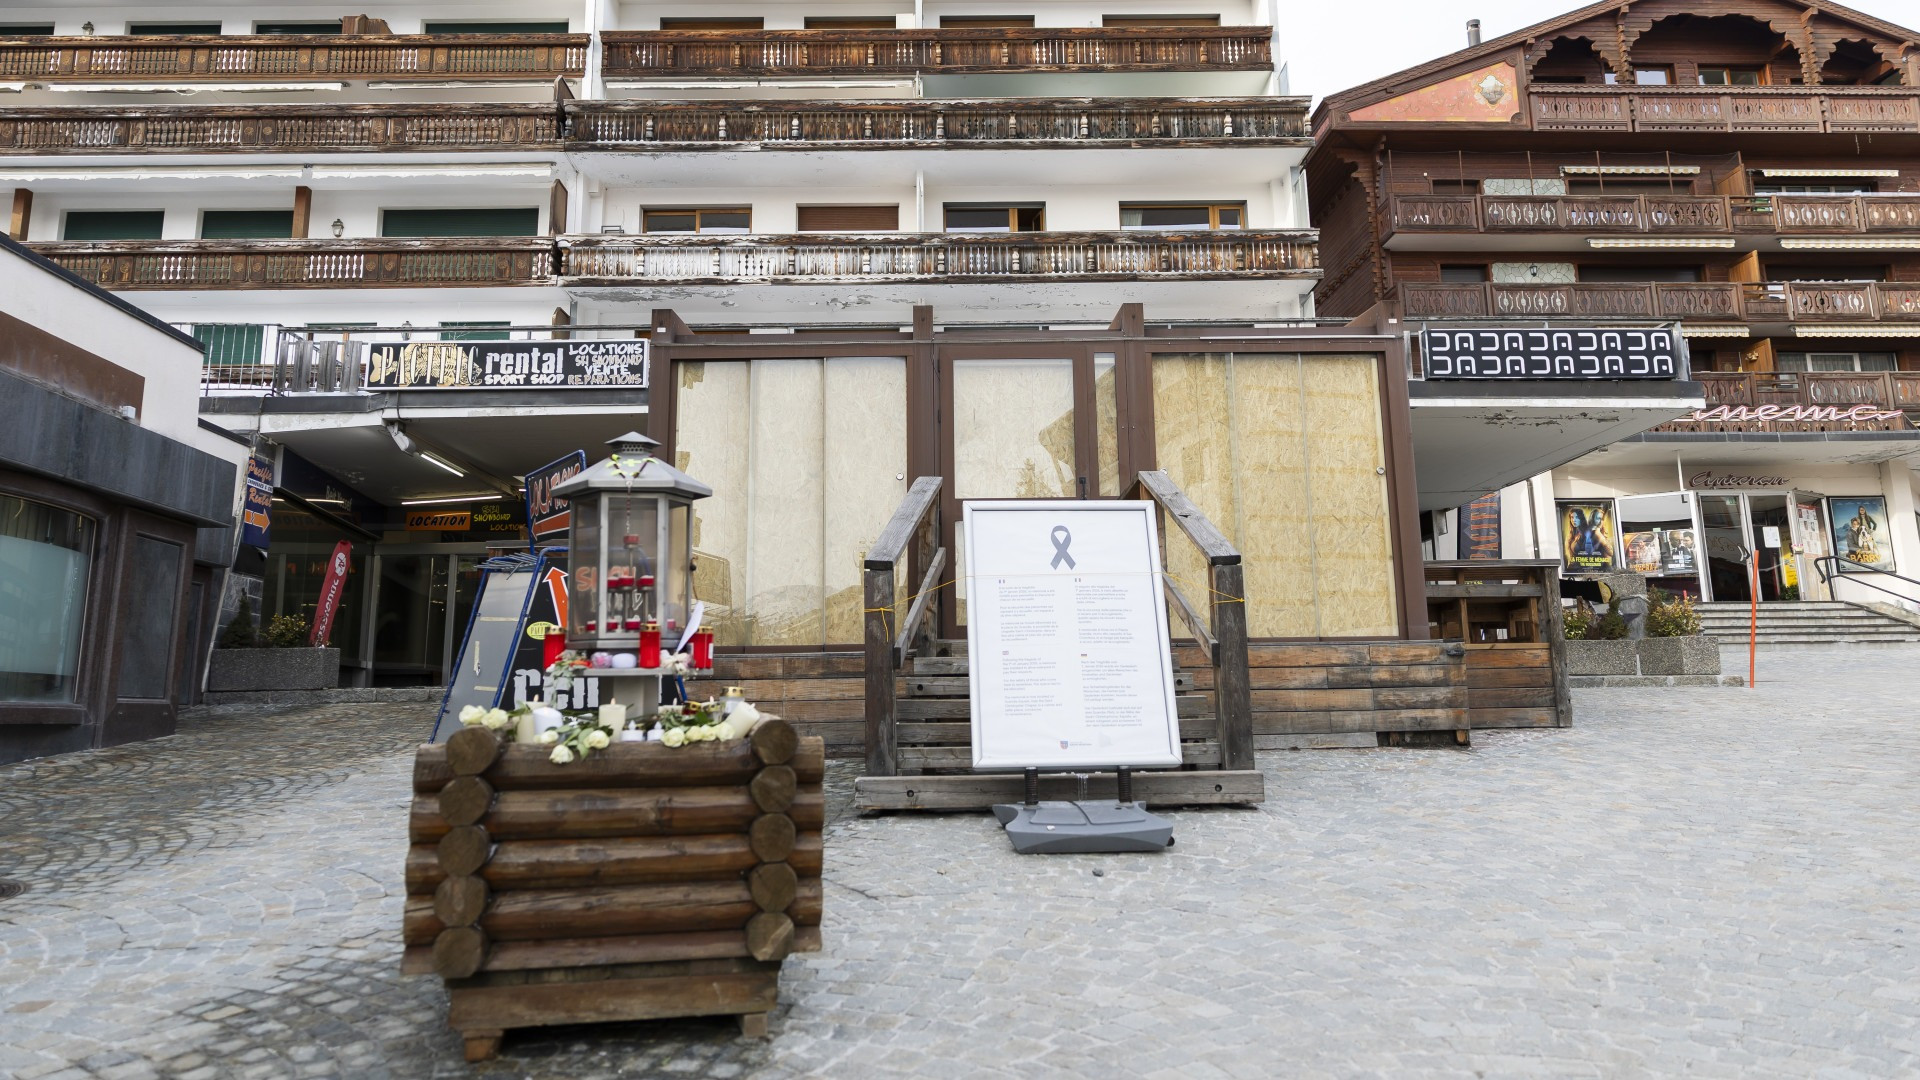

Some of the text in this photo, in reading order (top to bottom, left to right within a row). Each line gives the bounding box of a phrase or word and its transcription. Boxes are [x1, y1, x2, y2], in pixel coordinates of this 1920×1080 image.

[568, 343, 643, 356] LOCATIONS
[379, 345, 482, 386] PACIFIC
[485, 347, 564, 375] rental
[584, 363, 631, 376] VENTE
[484, 373, 565, 386] SPORT SHOP
[409, 515, 467, 527] LOCATION
[473, 513, 511, 522] SNOWBOARD
